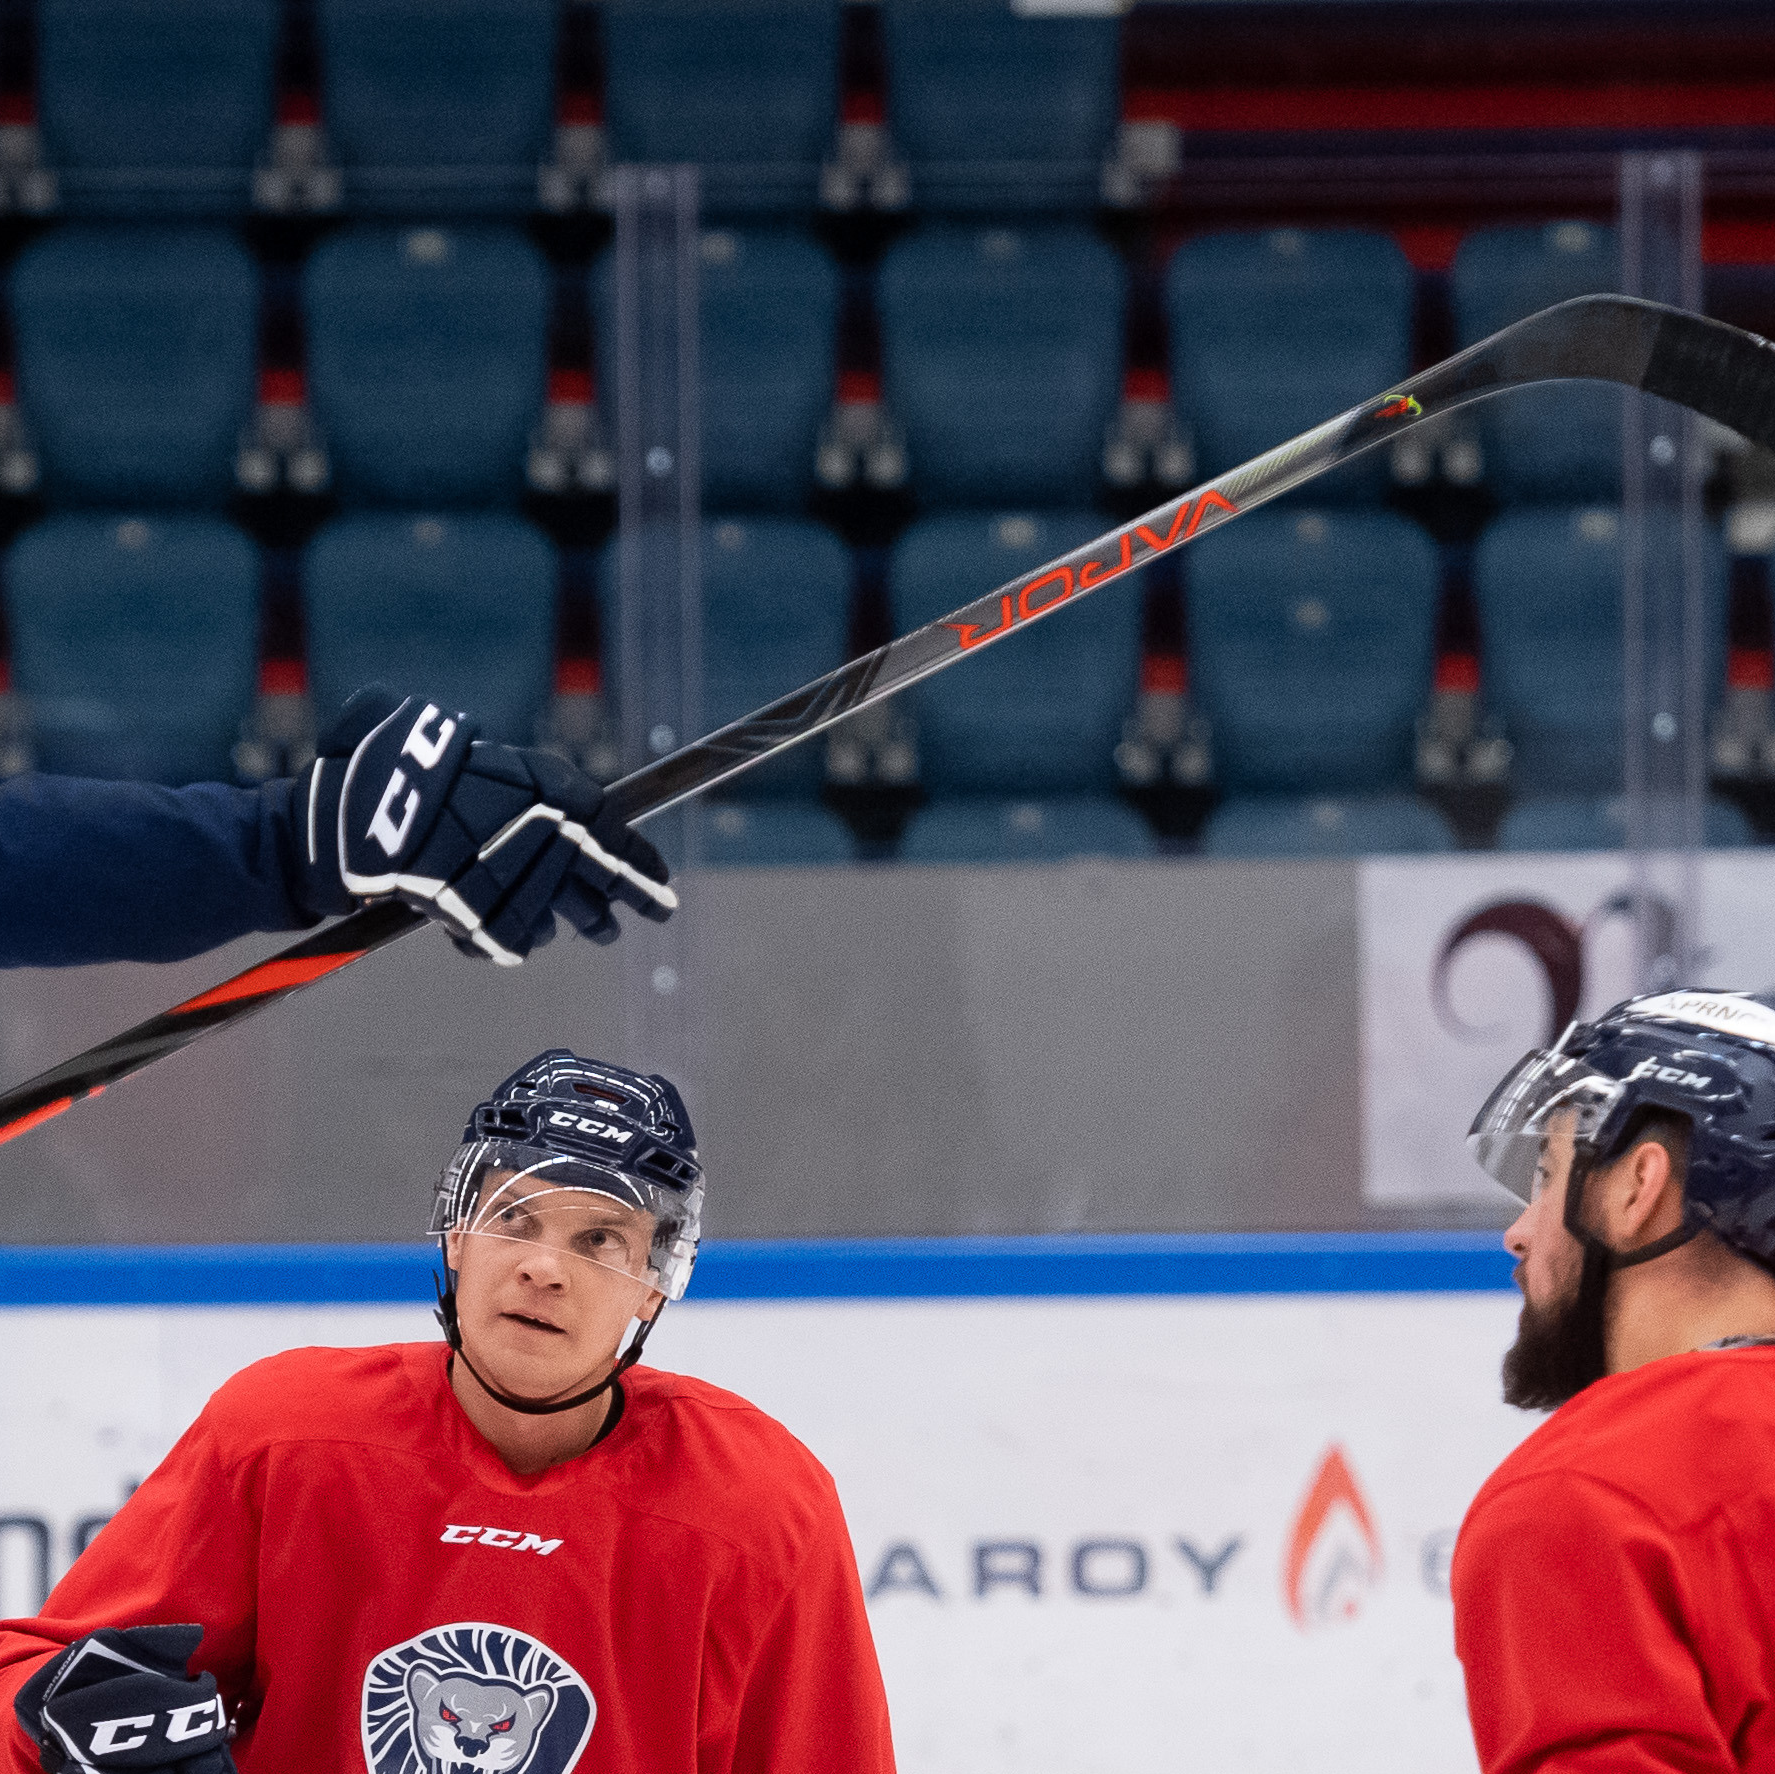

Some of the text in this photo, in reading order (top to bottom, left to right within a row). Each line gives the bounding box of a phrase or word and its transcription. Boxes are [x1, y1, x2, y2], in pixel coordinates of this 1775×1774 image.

[941, 490, 1238, 650] VAPOR
[365, 702, 467, 858] CC
[1638, 1056, 1713, 1091] CCM
[548, 1110, 634, 1145] CCM
[439, 1523, 564, 1556] CCM
[89, 1693, 226, 1756] CC
